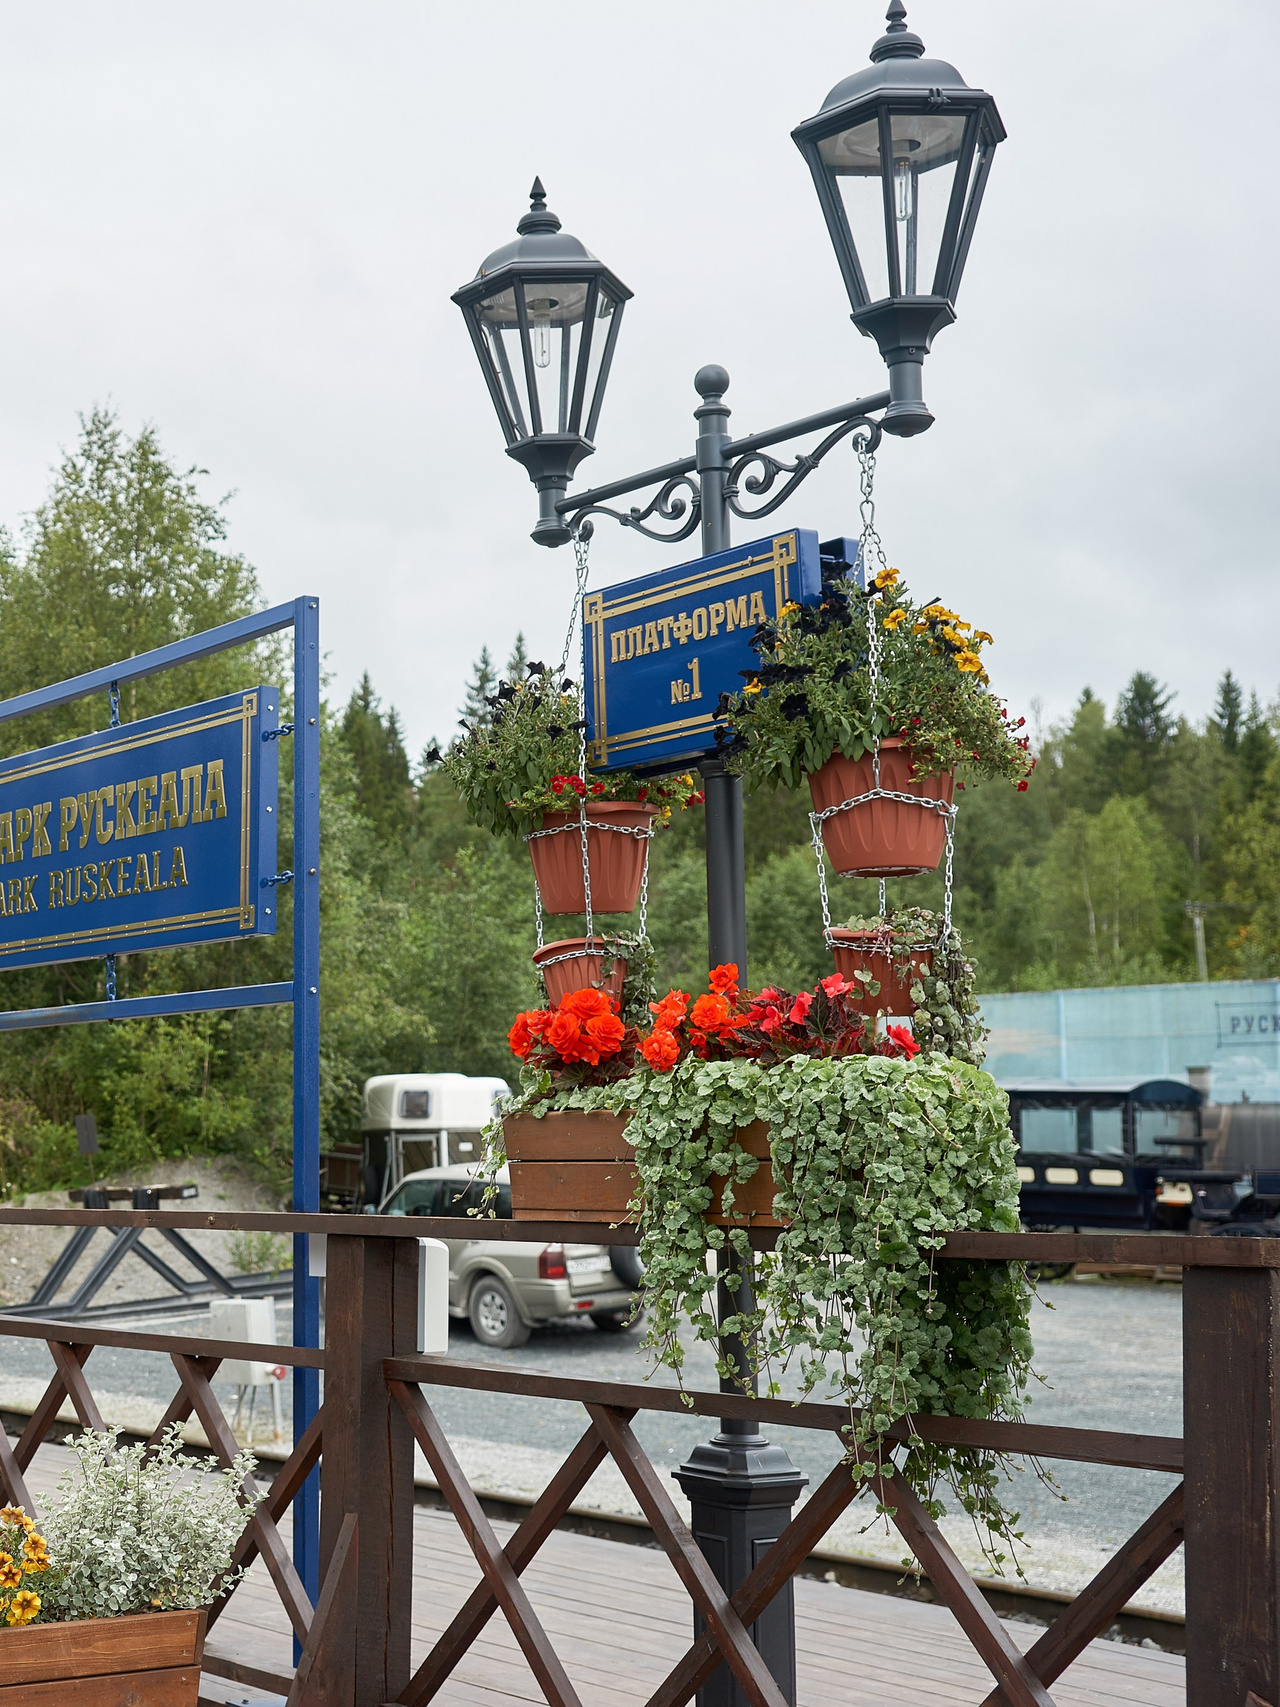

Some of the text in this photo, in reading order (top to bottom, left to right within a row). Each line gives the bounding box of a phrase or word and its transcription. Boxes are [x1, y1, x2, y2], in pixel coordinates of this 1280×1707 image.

[610, 590, 767, 663] ПЛАТФОРМА
[59, 758, 227, 851] РУСКЕАЛА
[48, 846, 189, 909] RUSKEALA
